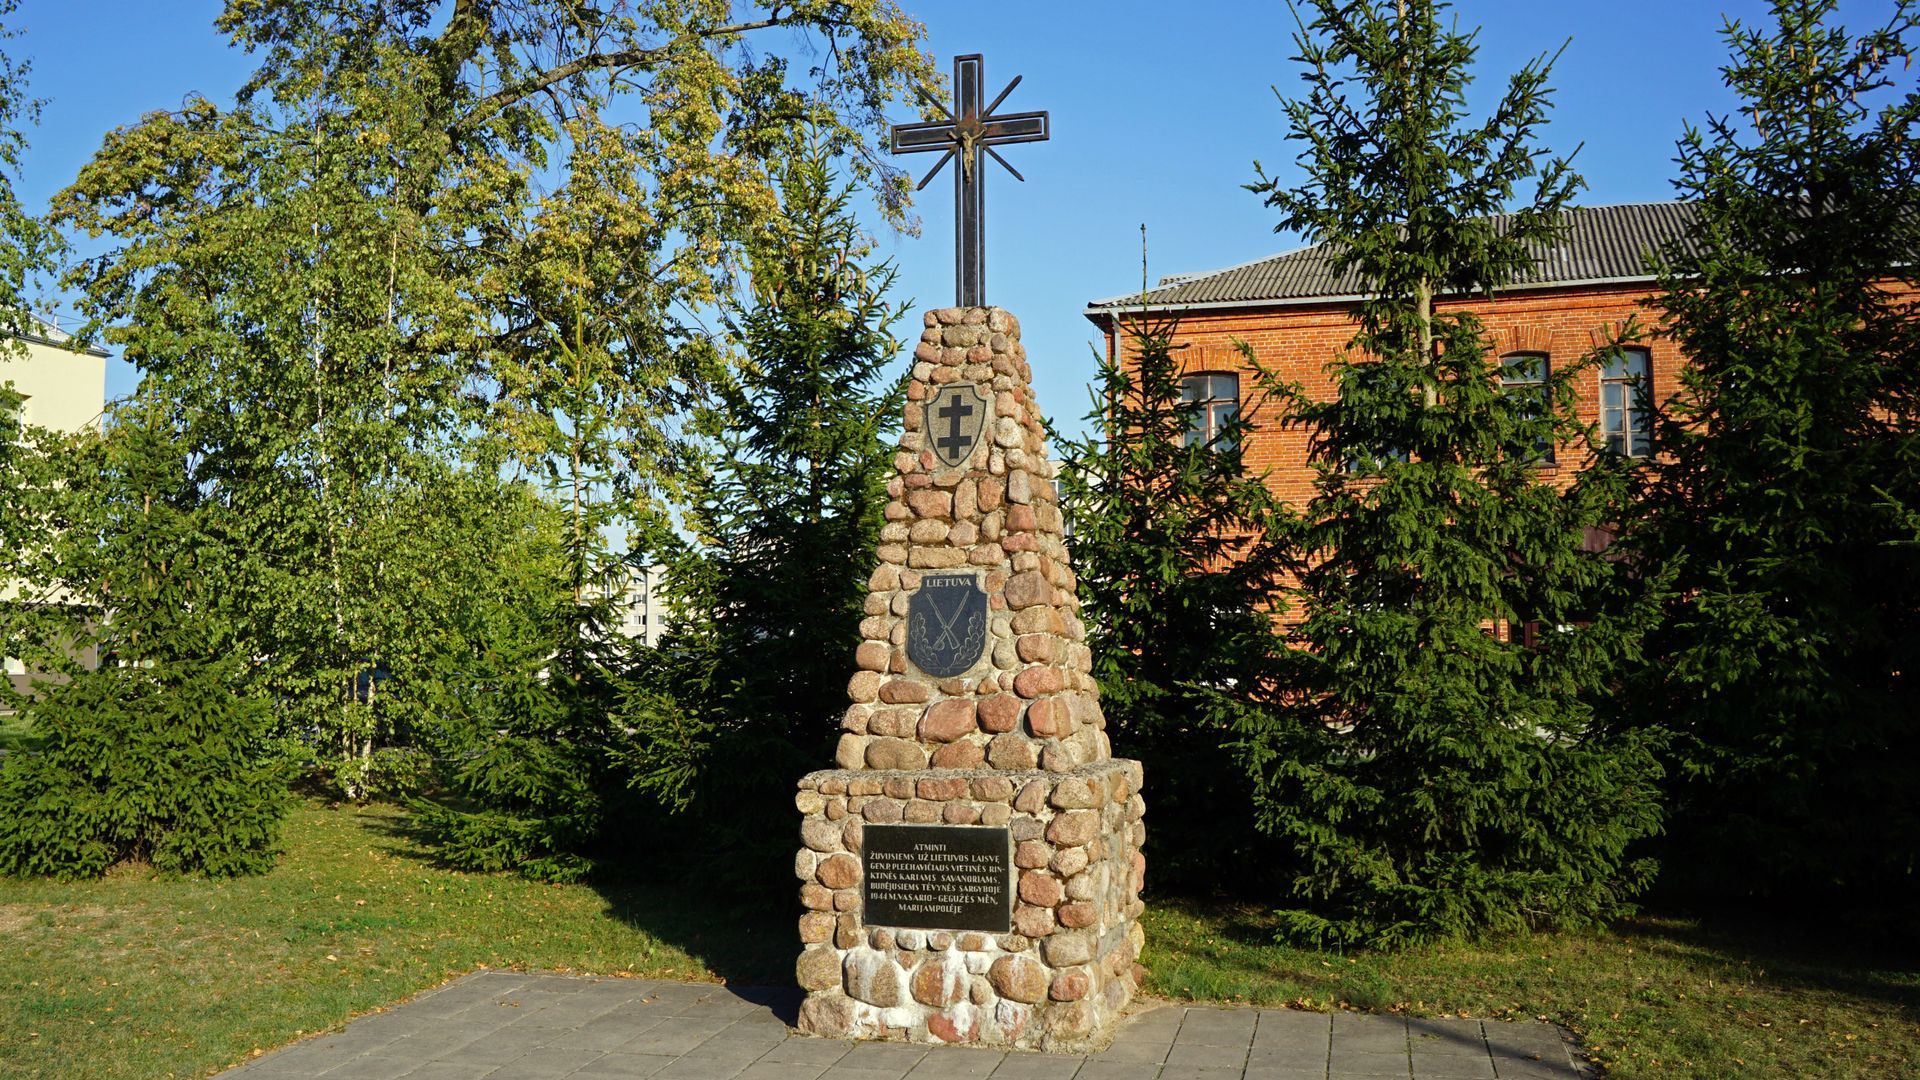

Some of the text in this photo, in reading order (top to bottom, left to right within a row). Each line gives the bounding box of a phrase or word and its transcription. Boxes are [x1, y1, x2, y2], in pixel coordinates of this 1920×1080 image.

[926, 578, 971, 587] LIETUVA
[914, 843, 946, 851] ATMINTI
[870, 851, 914, 860] ŽUVUSIEMS
[918, 852, 929, 861] UŽ
[930, 854, 969, 862] LIETUVOS
[892, 863, 949, 871] PLECHAVIČIAUS
[951, 864, 986, 872] VIETINĖS
[870, 871, 897, 880] KTINĖS
[899, 873, 936, 881] KARIAMS
[870, 882, 1002, 895] BUDĖJUSIEMS TĖVYNĖS SARGYBOJE
[938, 894, 974, 903] GEGUŽĖS
[899, 904, 962, 914] MARIJAMPOLĖJE
